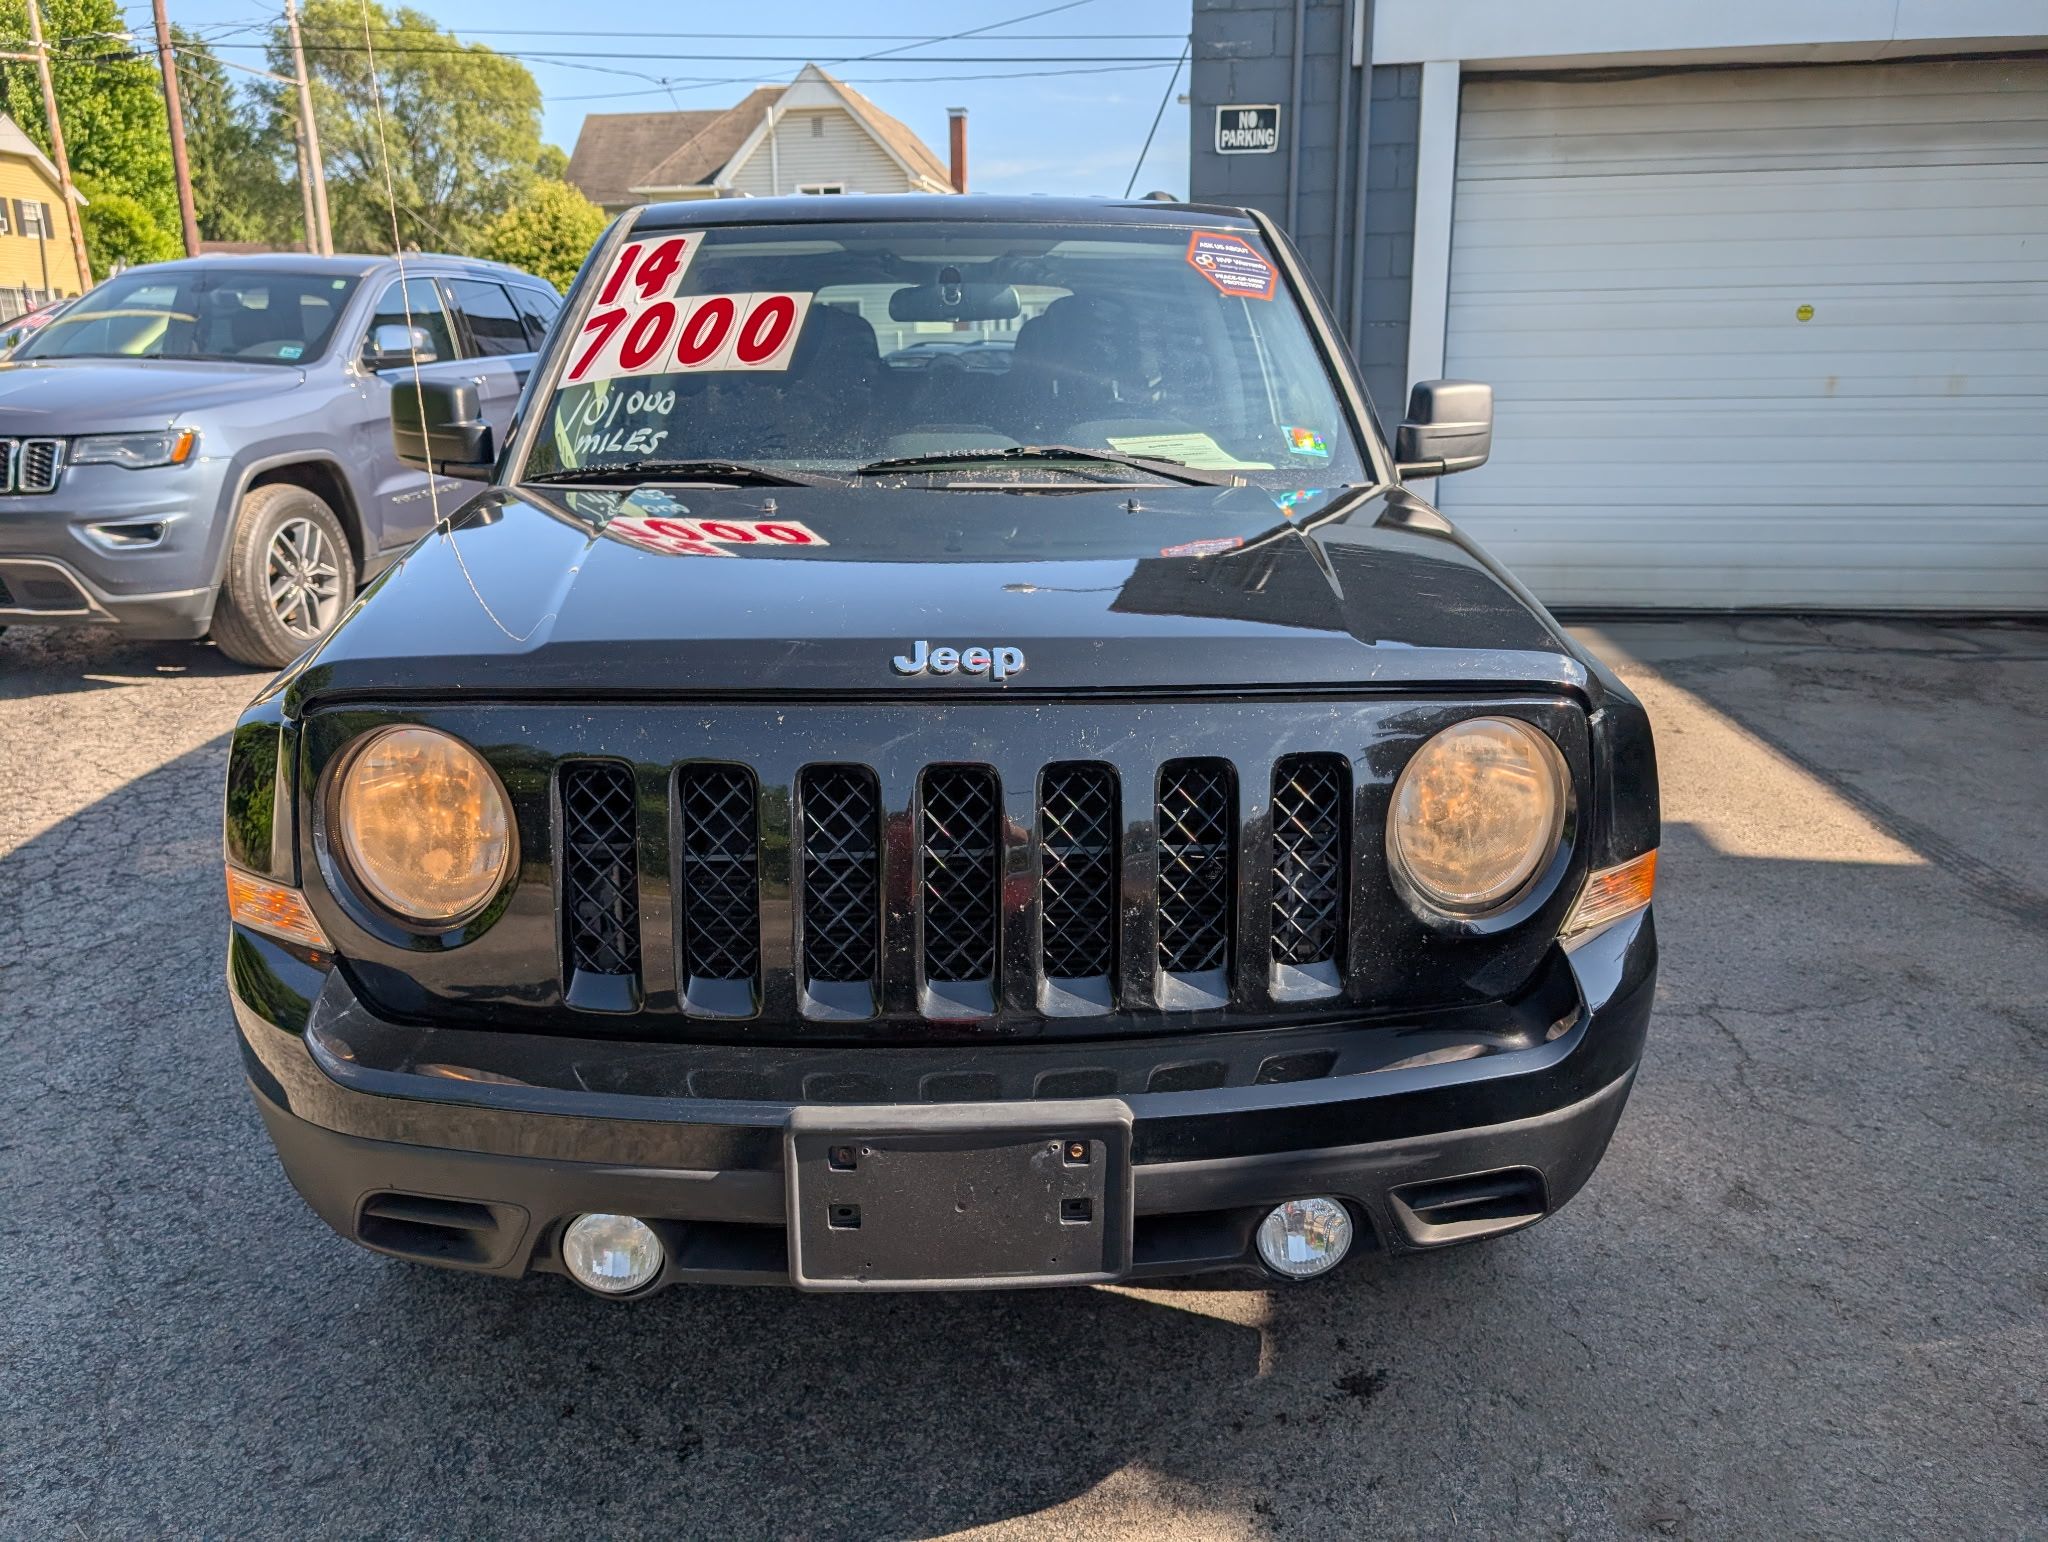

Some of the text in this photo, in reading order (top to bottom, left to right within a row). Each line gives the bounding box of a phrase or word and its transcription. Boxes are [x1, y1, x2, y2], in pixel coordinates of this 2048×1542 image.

[1220, 128, 1275, 148] PARKING
[1238, 110, 1258, 129] NO
[598, 238, 688, 305] 14
[567, 295, 796, 381] 7000
[892, 640, 1025, 681] Jeep
